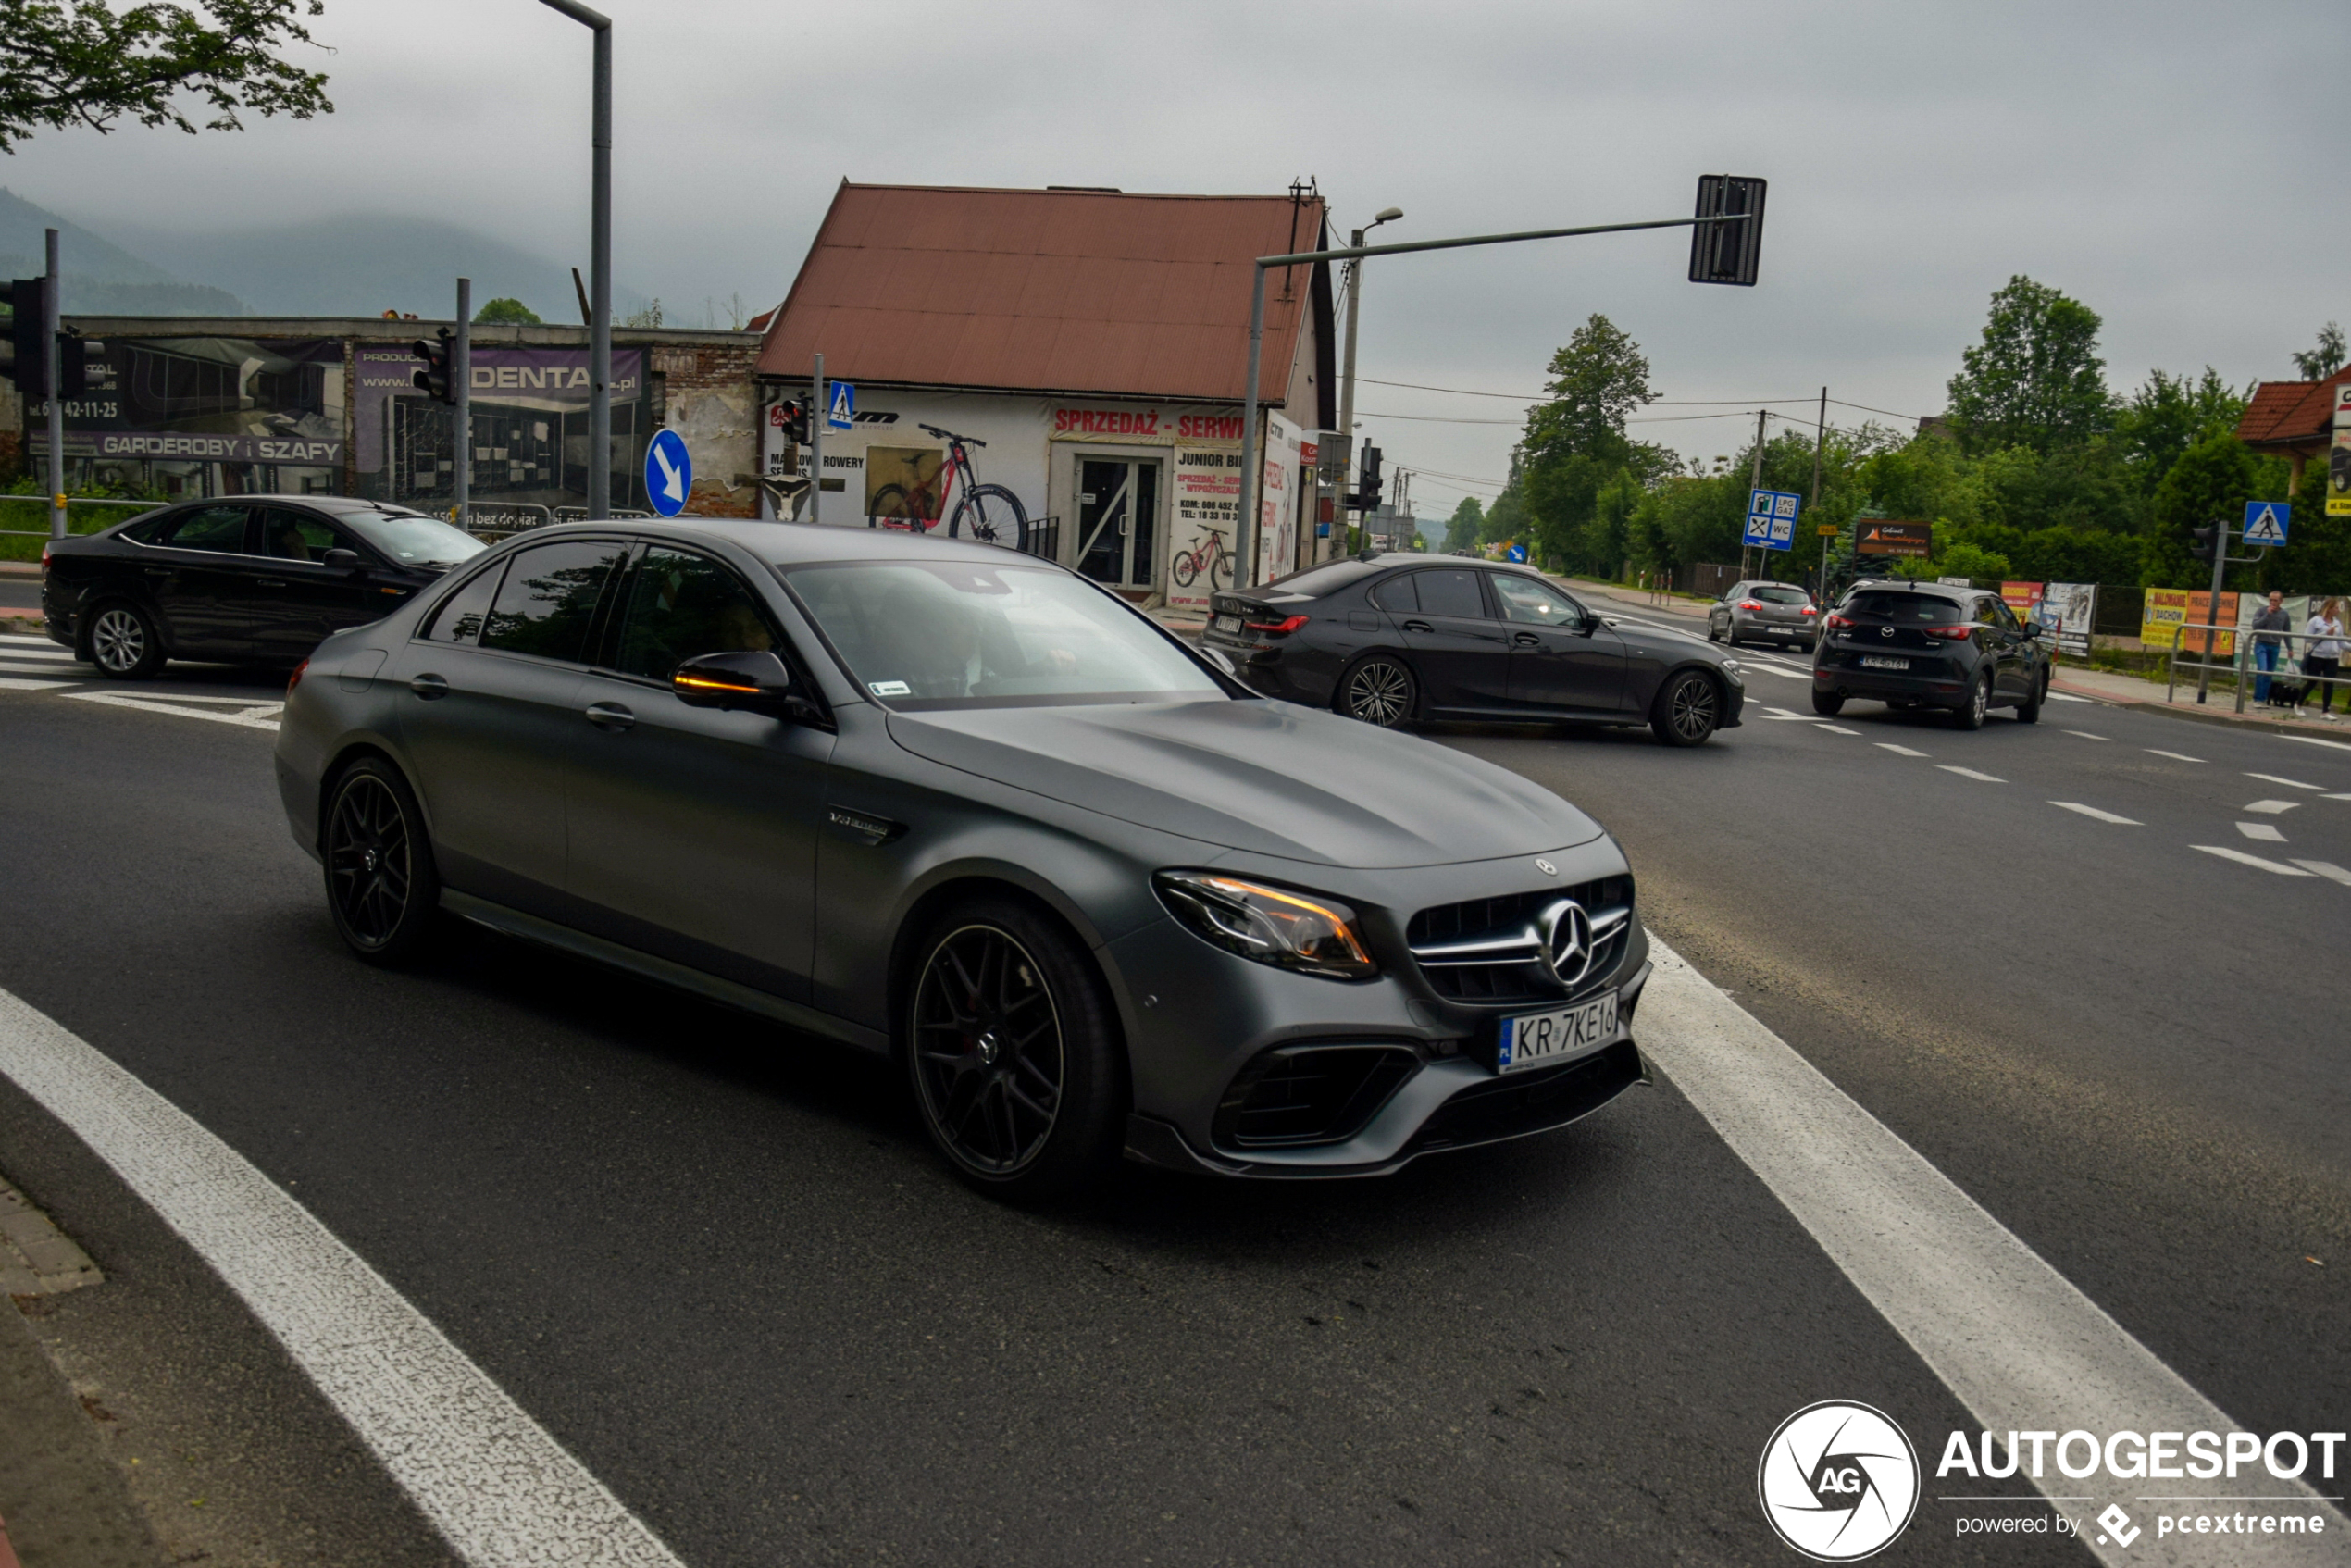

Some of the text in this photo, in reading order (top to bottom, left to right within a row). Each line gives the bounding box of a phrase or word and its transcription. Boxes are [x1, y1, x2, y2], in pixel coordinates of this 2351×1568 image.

[64, 401, 118, 418] 42-11-25
[1055, 409, 1159, 435] SPRZEDAŻ
[1178, 416, 1245, 439] SERWI
[104, 436, 238, 457] GARDEROBY
[246, 440, 252, 458] i
[259, 442, 340, 461] SZAFY
[1308, 446, 1318, 454] Ce
[823, 455, 864, 468] ROWERY
[1178, 453, 1223, 467] JUNIOR
[1177, 474, 1216, 484] SPRZEDAŻ
[1180, 500, 1200, 508] KOM:
[1218, 502, 1233, 510] 452
[1778, 498, 1794, 507] LPG
[1180, 510, 1196, 518] TEL:
[1209, 511, 1219, 520] 33
[1776, 506, 1794, 516] GAZ
[476, 513, 497, 525] bez
[1773, 525, 1789, 534] WC
[1518, 997, 1614, 1059] KR 7KE16
[1499, 1048, 1511, 1058] PL
